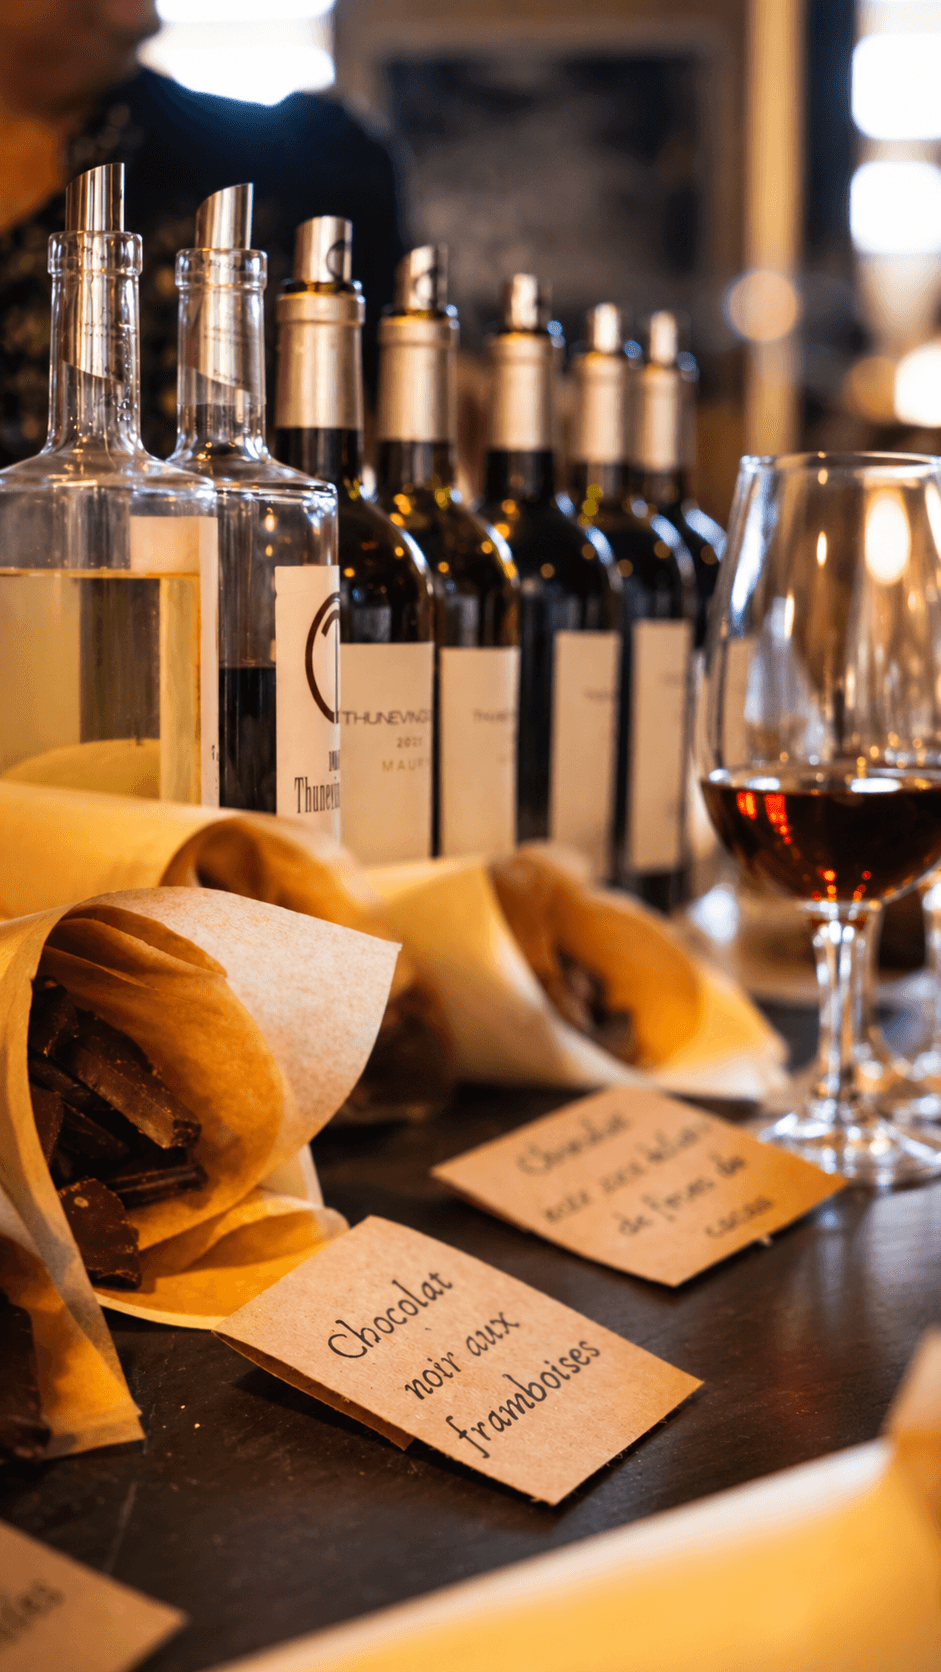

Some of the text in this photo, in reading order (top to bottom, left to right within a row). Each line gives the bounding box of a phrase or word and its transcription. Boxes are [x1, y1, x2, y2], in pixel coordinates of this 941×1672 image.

[328, 1272, 453, 1359] Chocolat
[404, 1311, 521, 1400] noir aux
[445, 1340, 600, 1459] framboises
